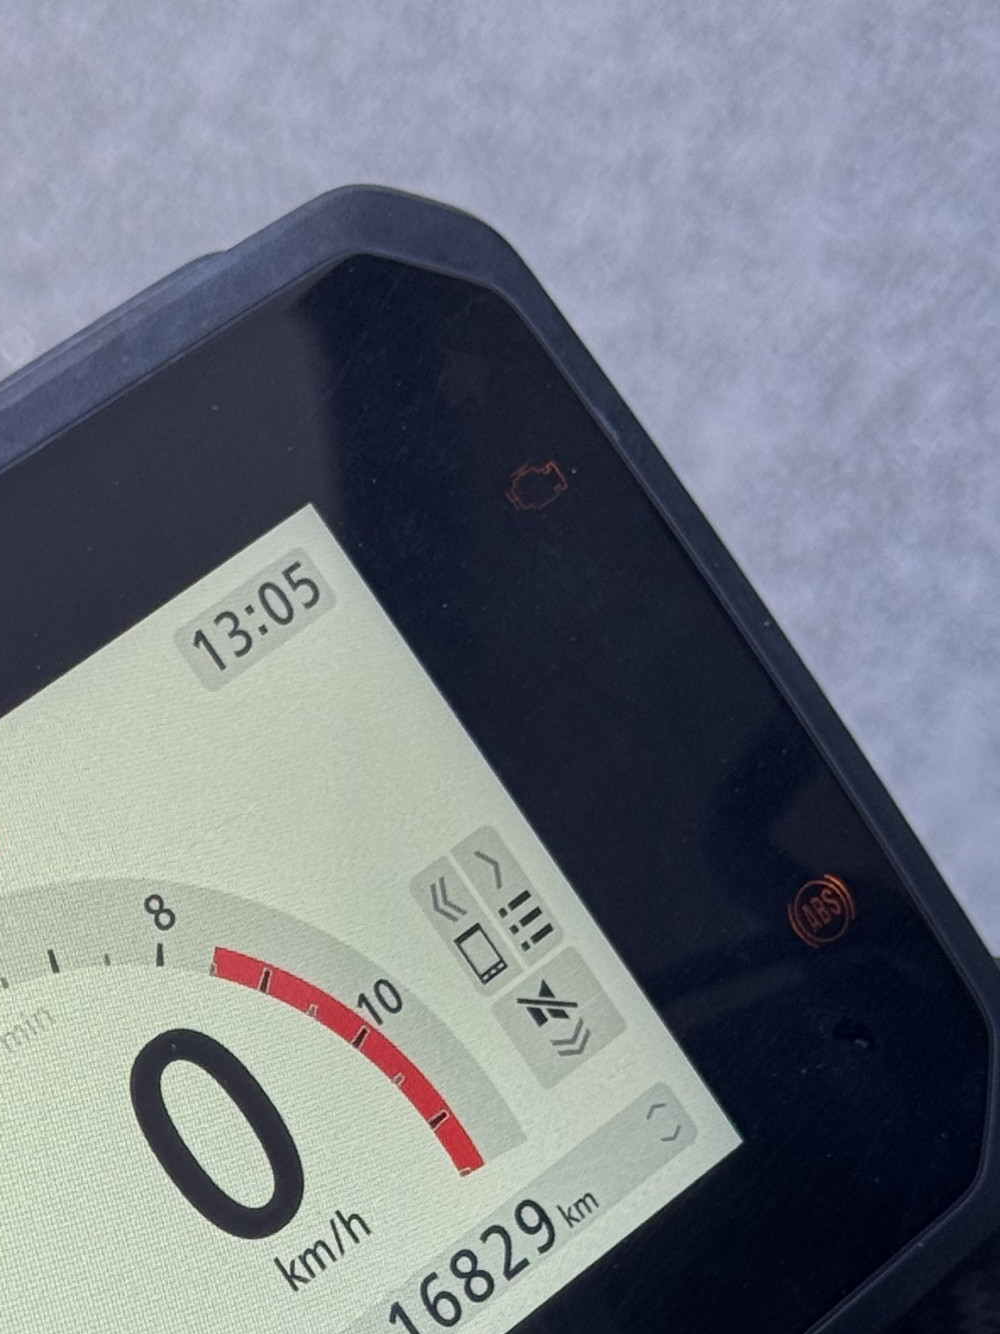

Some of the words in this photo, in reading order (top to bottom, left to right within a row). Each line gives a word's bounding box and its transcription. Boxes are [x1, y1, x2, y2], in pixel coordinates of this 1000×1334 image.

[192, 561, 320, 671] 13:05
[144, 894, 176, 931] 8
[804, 888, 841, 930] ABS
[358, 979, 403, 1025] 10
[130, 1028, 304, 1239] 0
[557, 1190, 599, 1228] km
[274, 1210, 372, 1291] km/h
